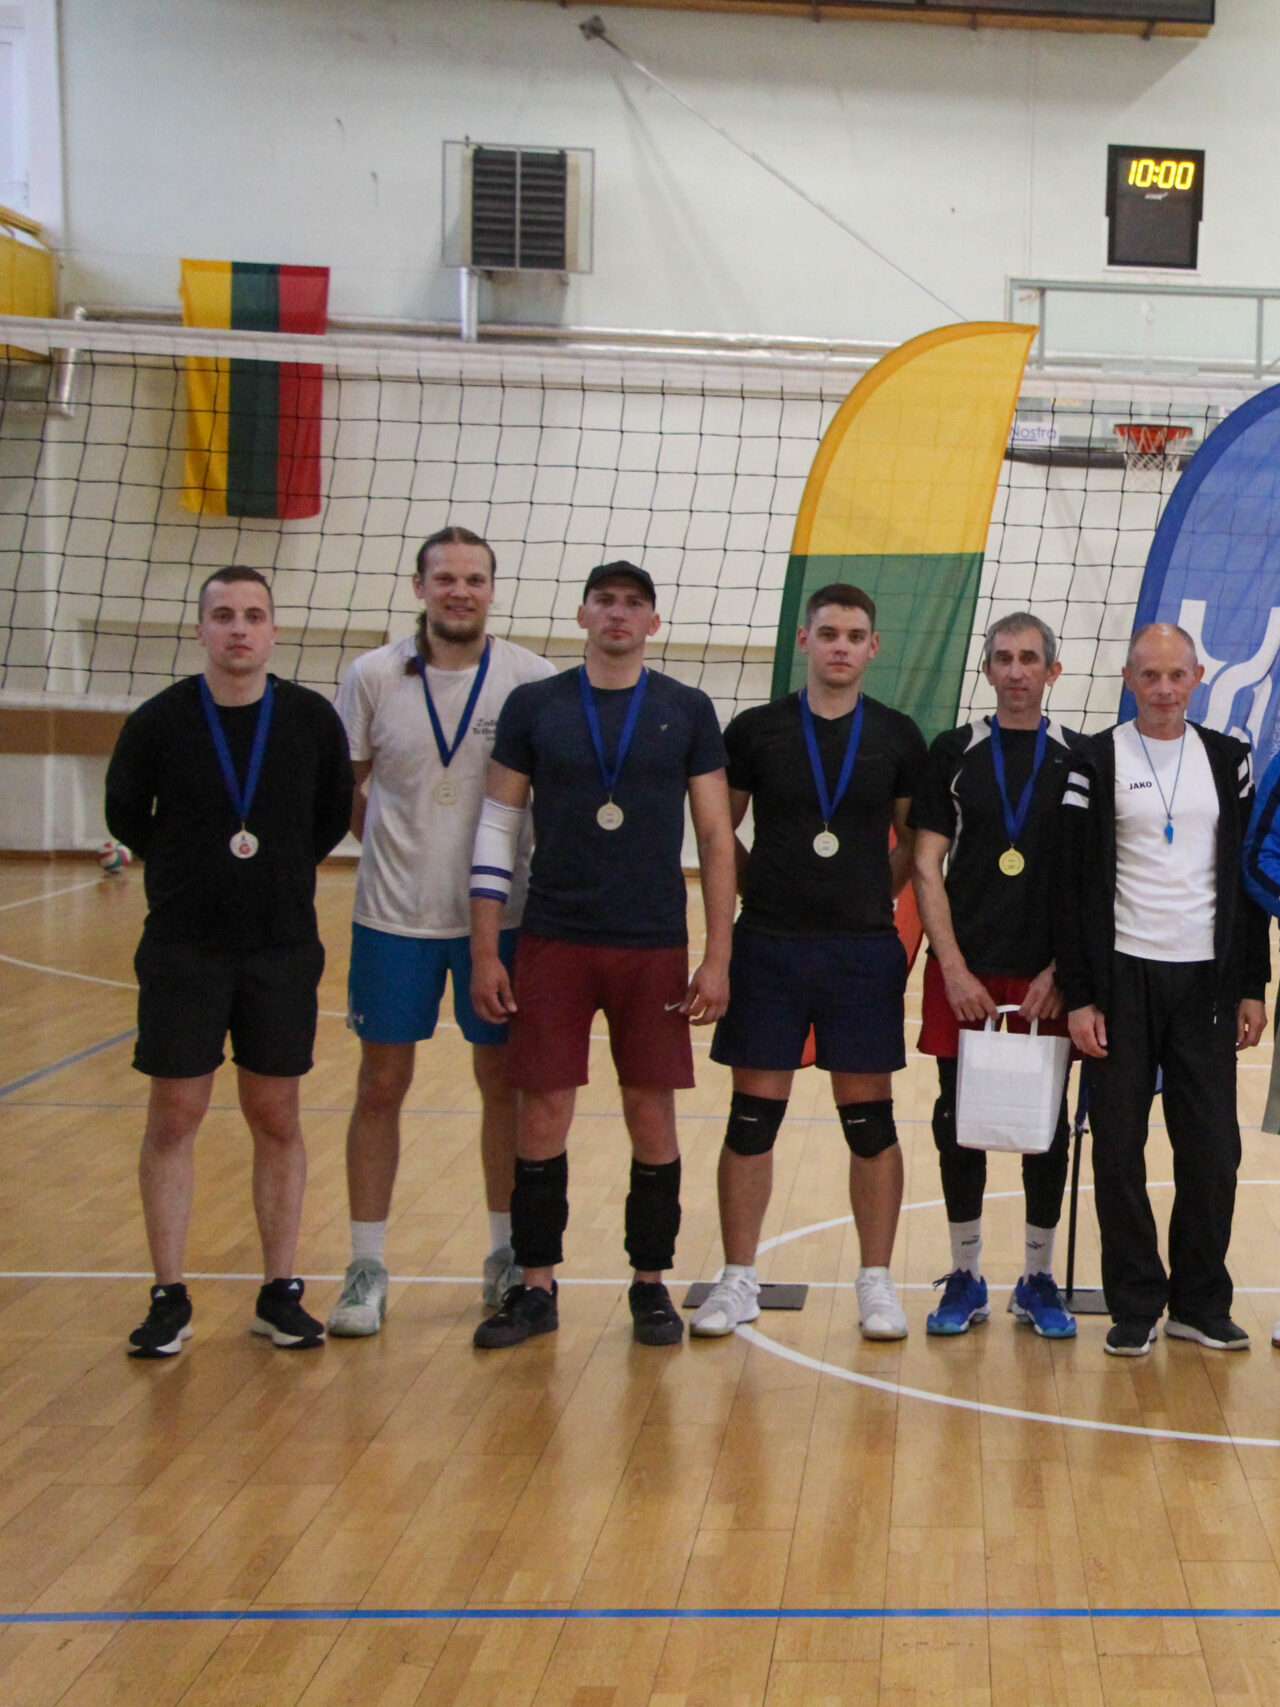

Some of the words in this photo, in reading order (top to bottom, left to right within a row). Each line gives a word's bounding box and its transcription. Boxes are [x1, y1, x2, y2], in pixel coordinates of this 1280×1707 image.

[1128, 158, 1195, 190] 10:00
[1010, 425, 1057, 440] Nostra
[1129, 780, 1153, 791] JAKO
